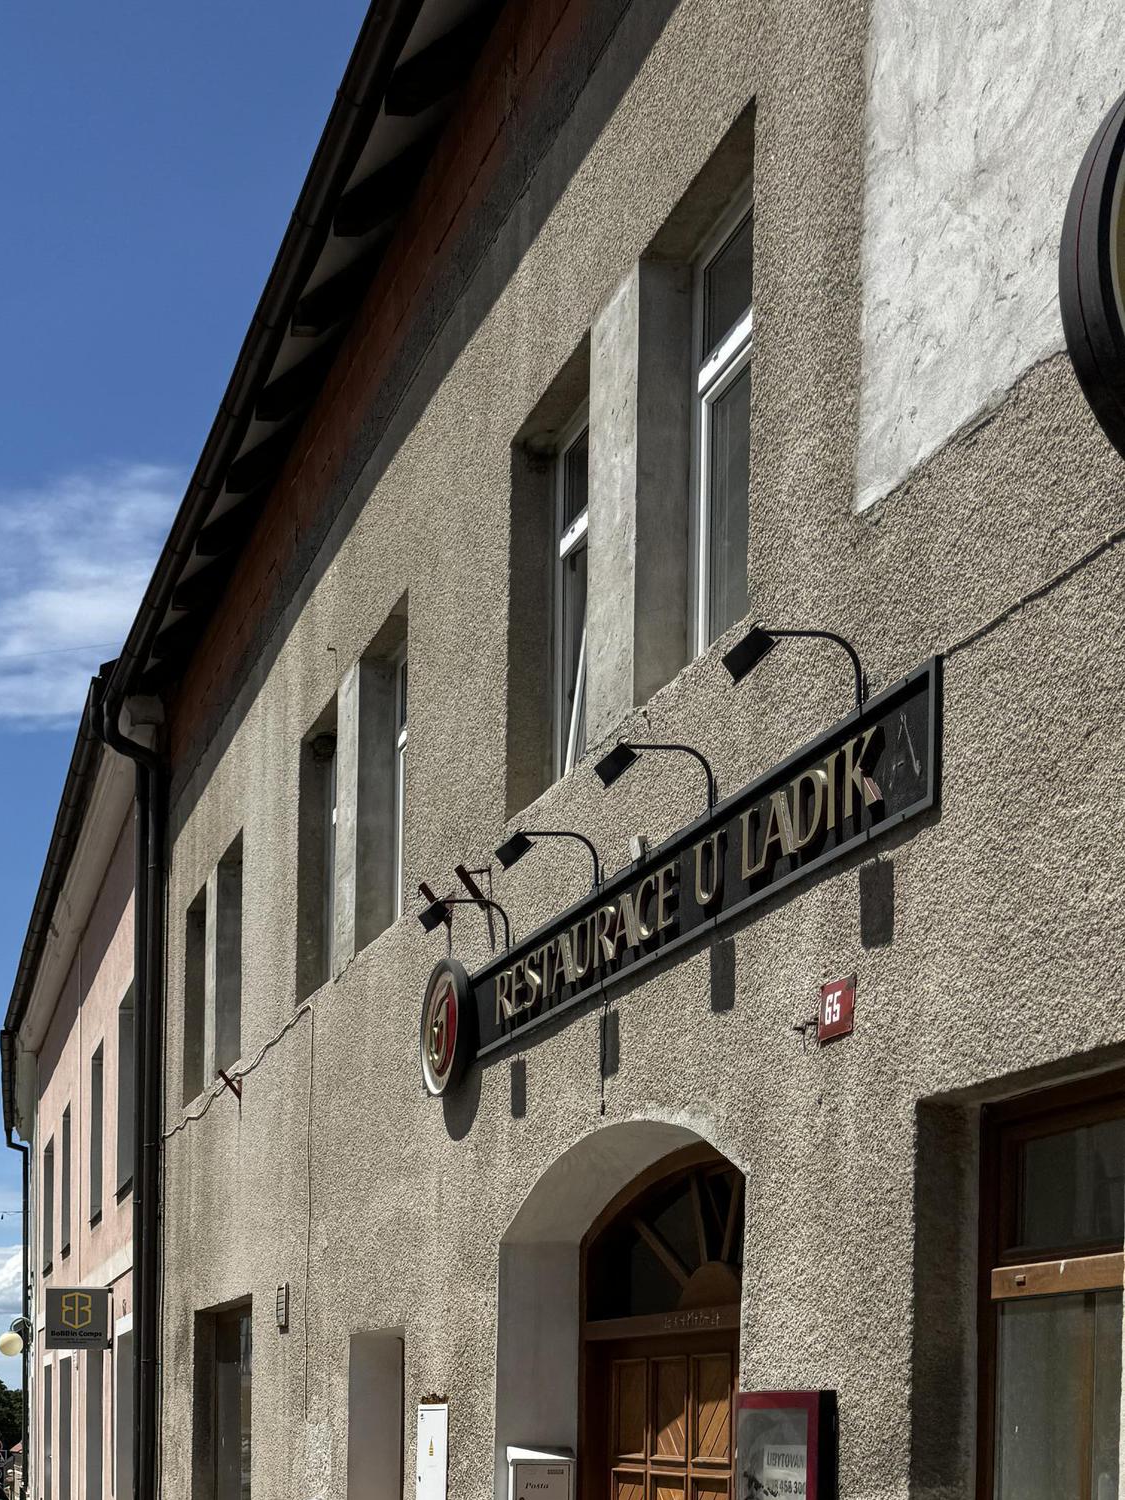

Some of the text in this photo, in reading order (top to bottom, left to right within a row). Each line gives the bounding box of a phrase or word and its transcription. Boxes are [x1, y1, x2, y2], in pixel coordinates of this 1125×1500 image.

[494, 862, 675, 1025] RESTAURACE
[693, 829, 725, 906] U
[824, 990, 843, 1026] 65
